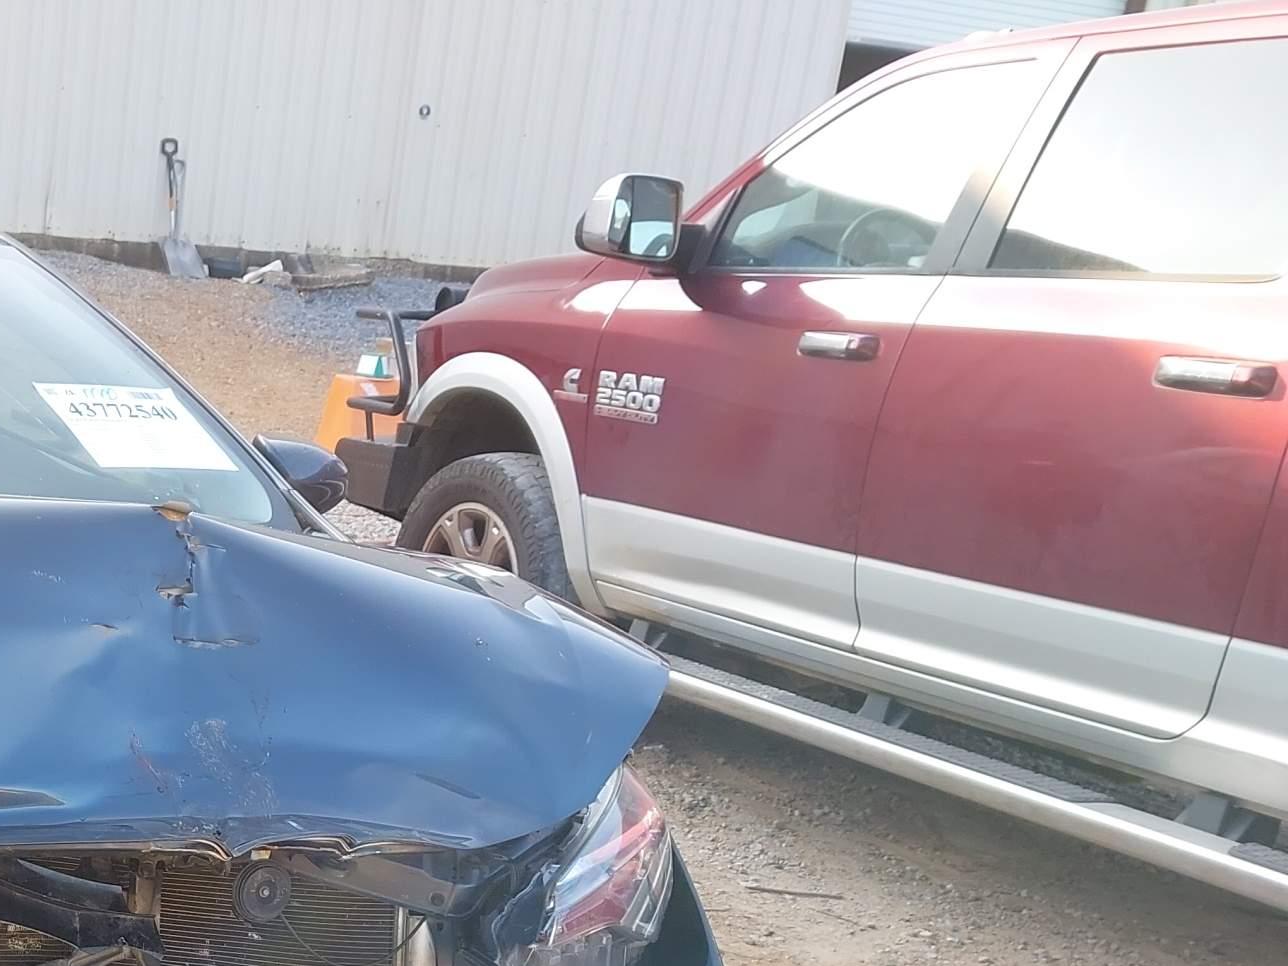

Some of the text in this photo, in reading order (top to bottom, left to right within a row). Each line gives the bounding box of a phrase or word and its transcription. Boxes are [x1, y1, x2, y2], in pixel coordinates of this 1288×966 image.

[598, 370, 666, 395] RAM
[68, 402, 178, 421] 43772540
[595, 387, 662, 413] 2500
